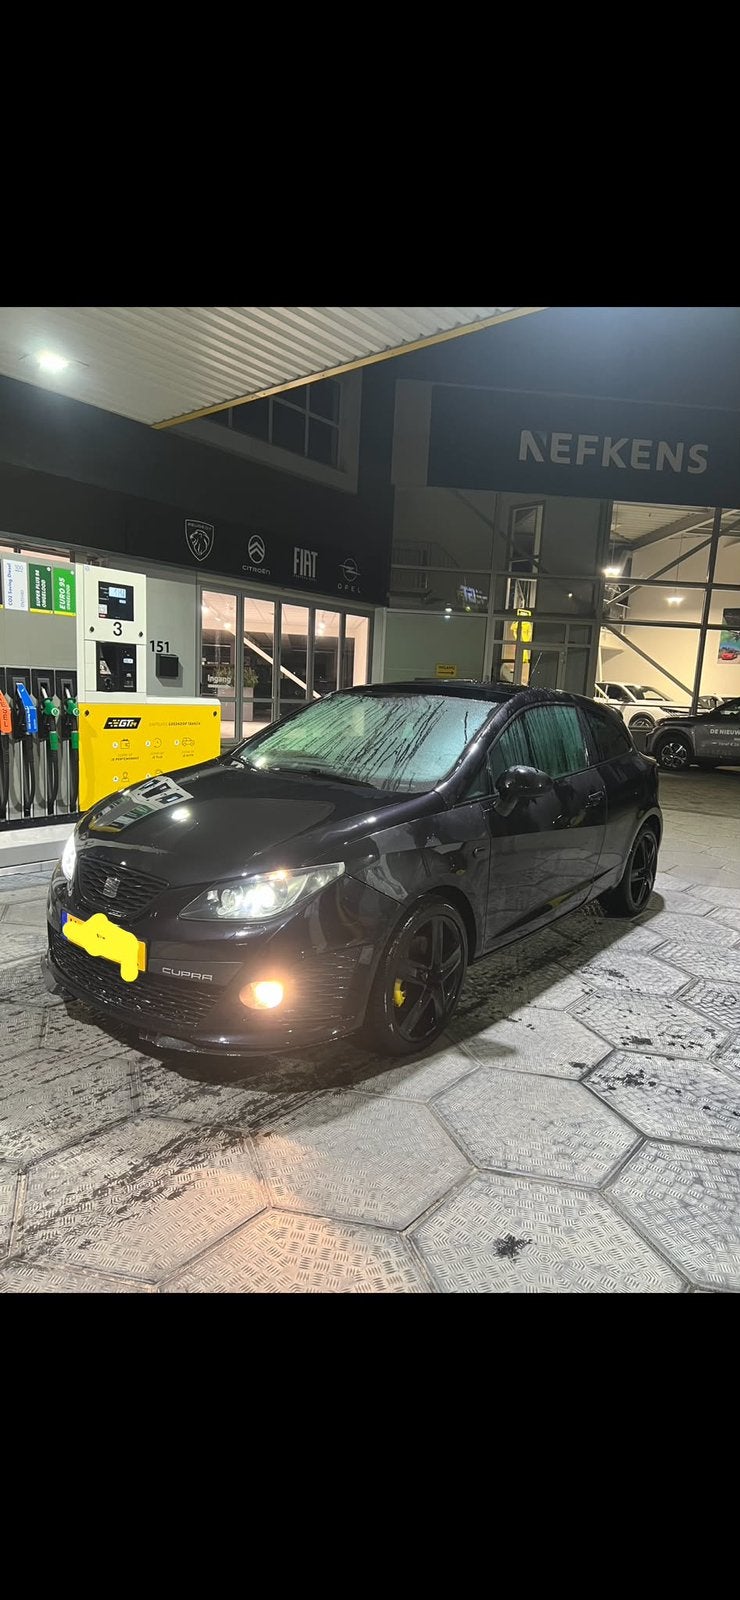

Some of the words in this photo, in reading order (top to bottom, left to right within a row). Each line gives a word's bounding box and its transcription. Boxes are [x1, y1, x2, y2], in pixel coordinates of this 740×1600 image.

[518, 430, 709, 474] NEFKENS
[293, 547, 318, 578] FIAT
[59, 576, 66, 588] 95
[337, 583, 361, 594] OPEL
[113, 622, 123, 636] 3
[150, 640, 170, 653] 151
[207, 673, 232, 685] Ingang
[161, 966, 214, 981] CUPRA
